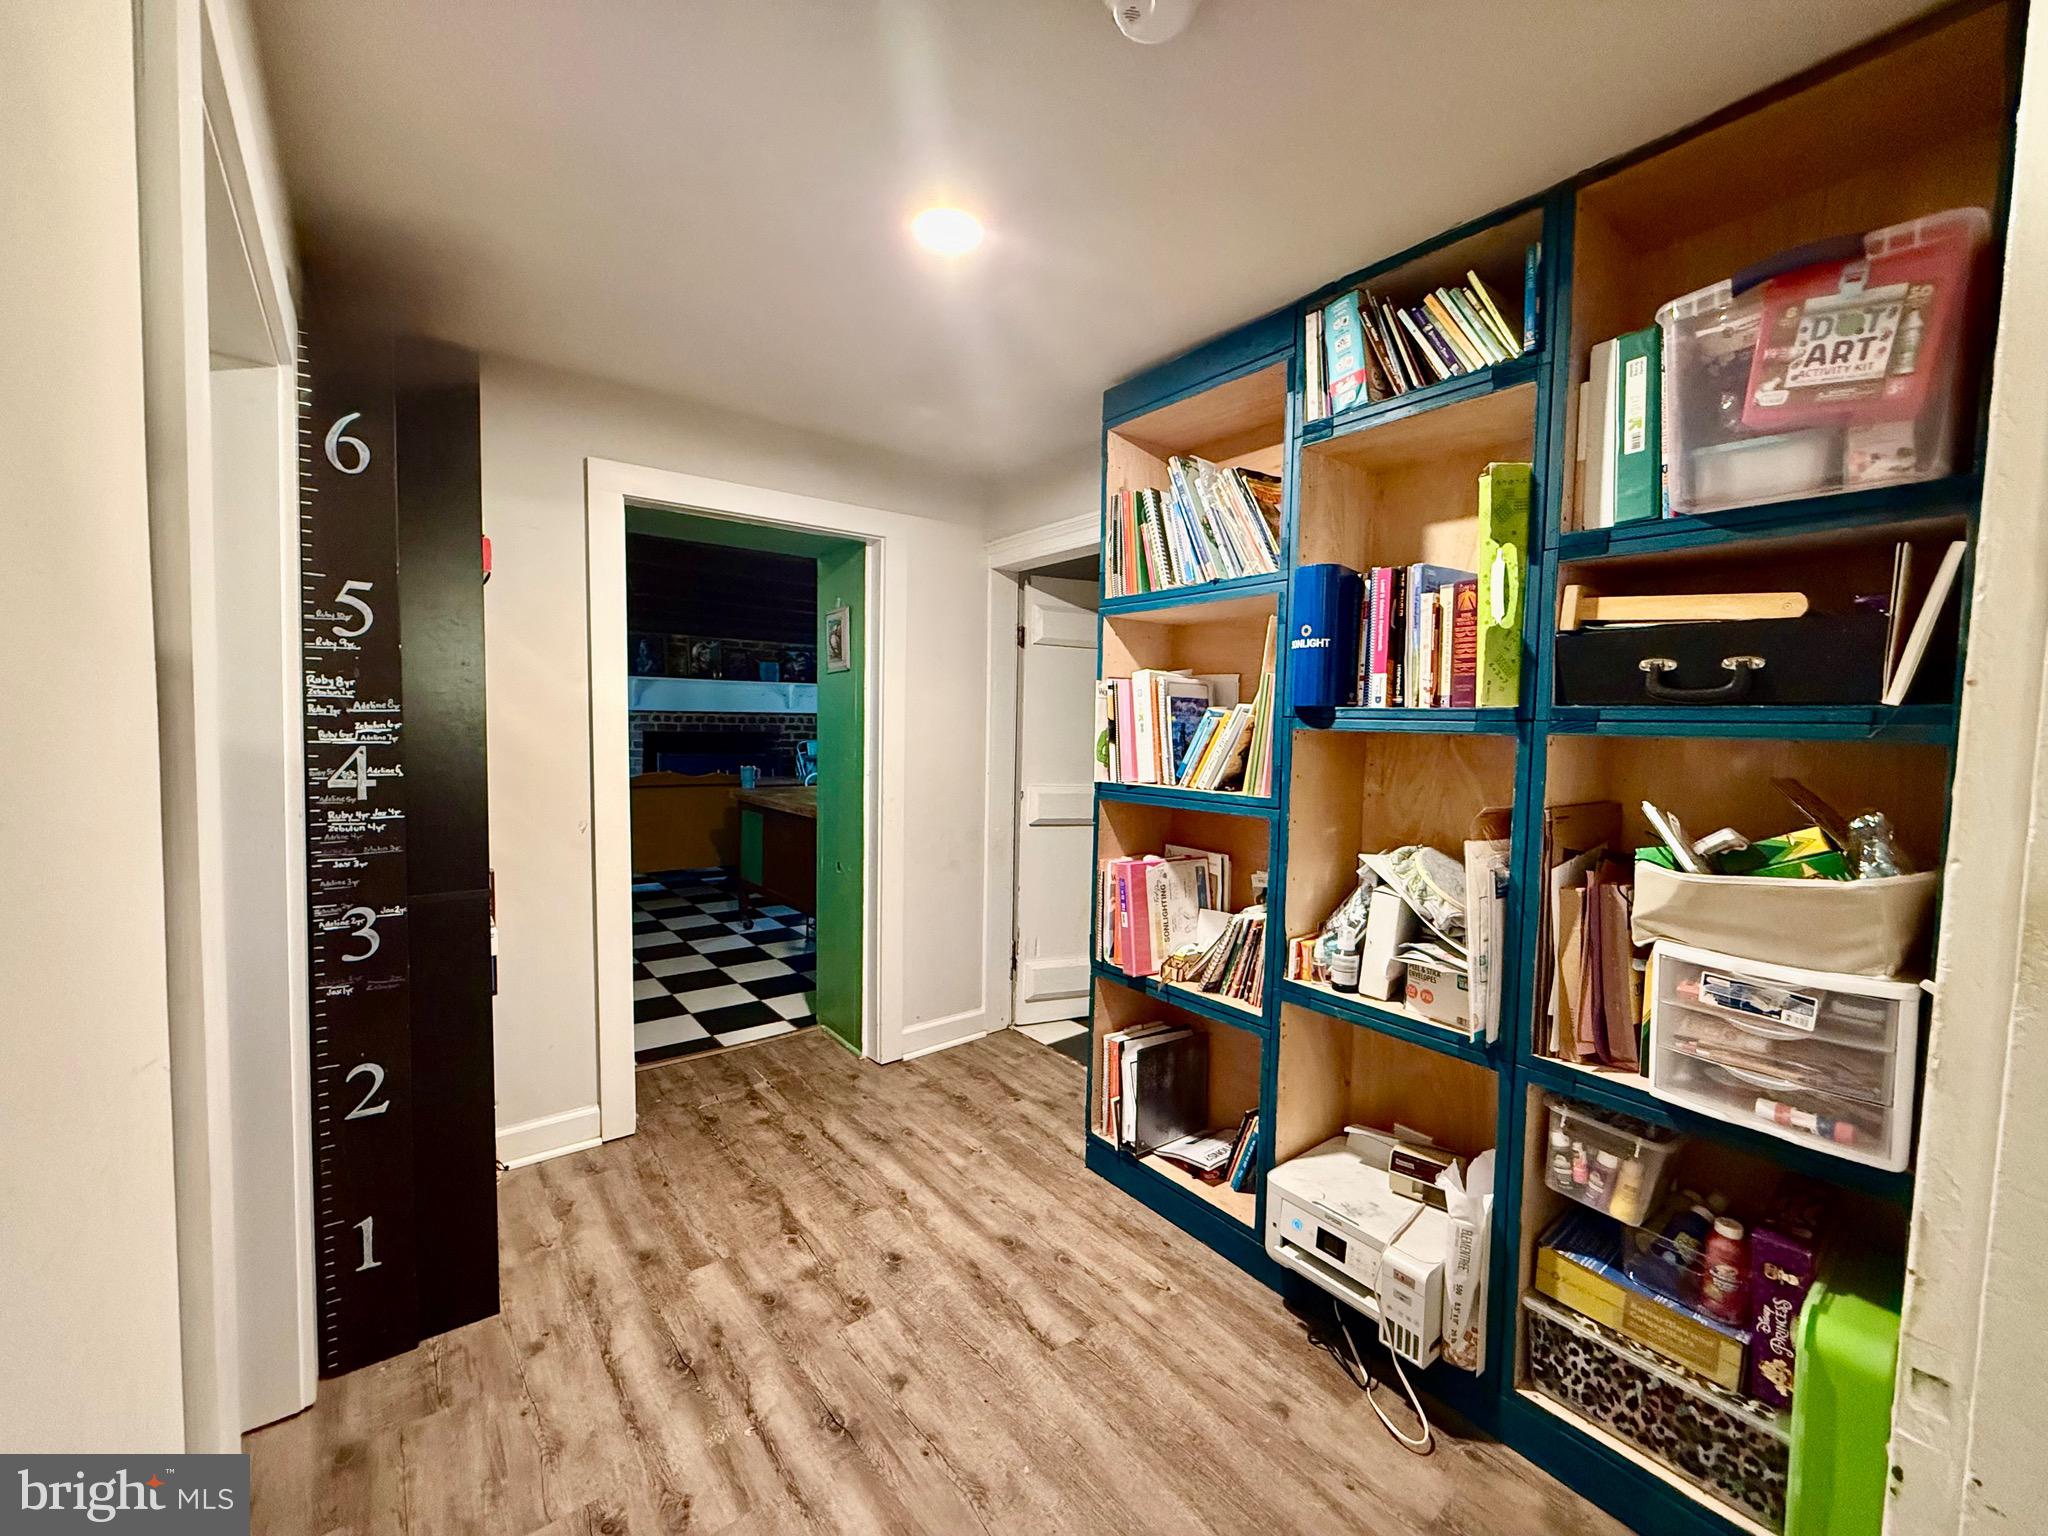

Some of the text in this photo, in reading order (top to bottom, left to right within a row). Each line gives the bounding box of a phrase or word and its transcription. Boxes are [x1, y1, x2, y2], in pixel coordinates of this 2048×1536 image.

[1799, 365, 1851, 378] ACTIVITY
[1856, 362, 1874, 371] KIT
[1804, 336, 1878, 368] ART
[324, 412, 371, 474] 6
[332, 580, 374, 637] 5
[327, 745, 377, 801] 4
[327, 811, 353, 820] Ruby
[341, 906, 381, 962] 3
[1160, 884, 1171, 943] SONLIGHTING
[1408, 969, 1437, 984] ENVELOPES
[344, 1062, 390, 1121] 2
[352, 1216, 382, 1272] 1
